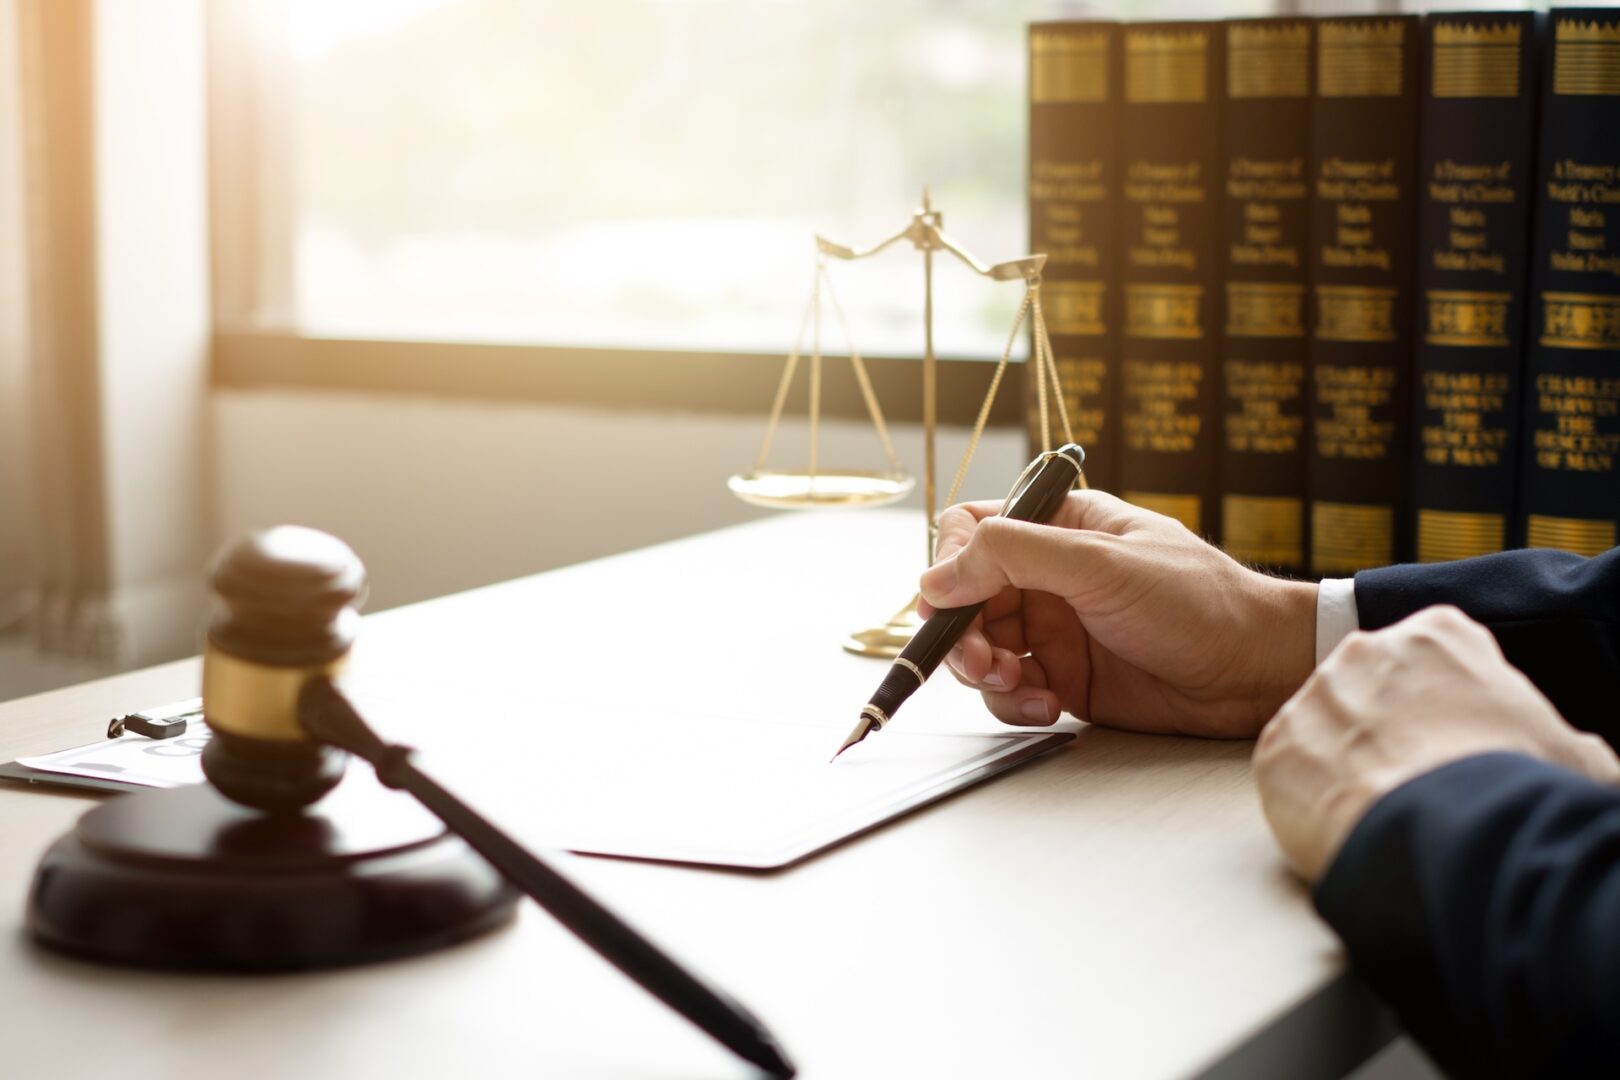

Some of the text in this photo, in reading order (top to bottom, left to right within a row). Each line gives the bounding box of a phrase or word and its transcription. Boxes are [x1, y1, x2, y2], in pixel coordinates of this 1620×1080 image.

[1445, 411, 1480, 428] THE
[1558, 415, 1594, 432] THE
[1425, 447, 1499, 467] OF MAN
[1537, 450, 1612, 472] OF MAN
